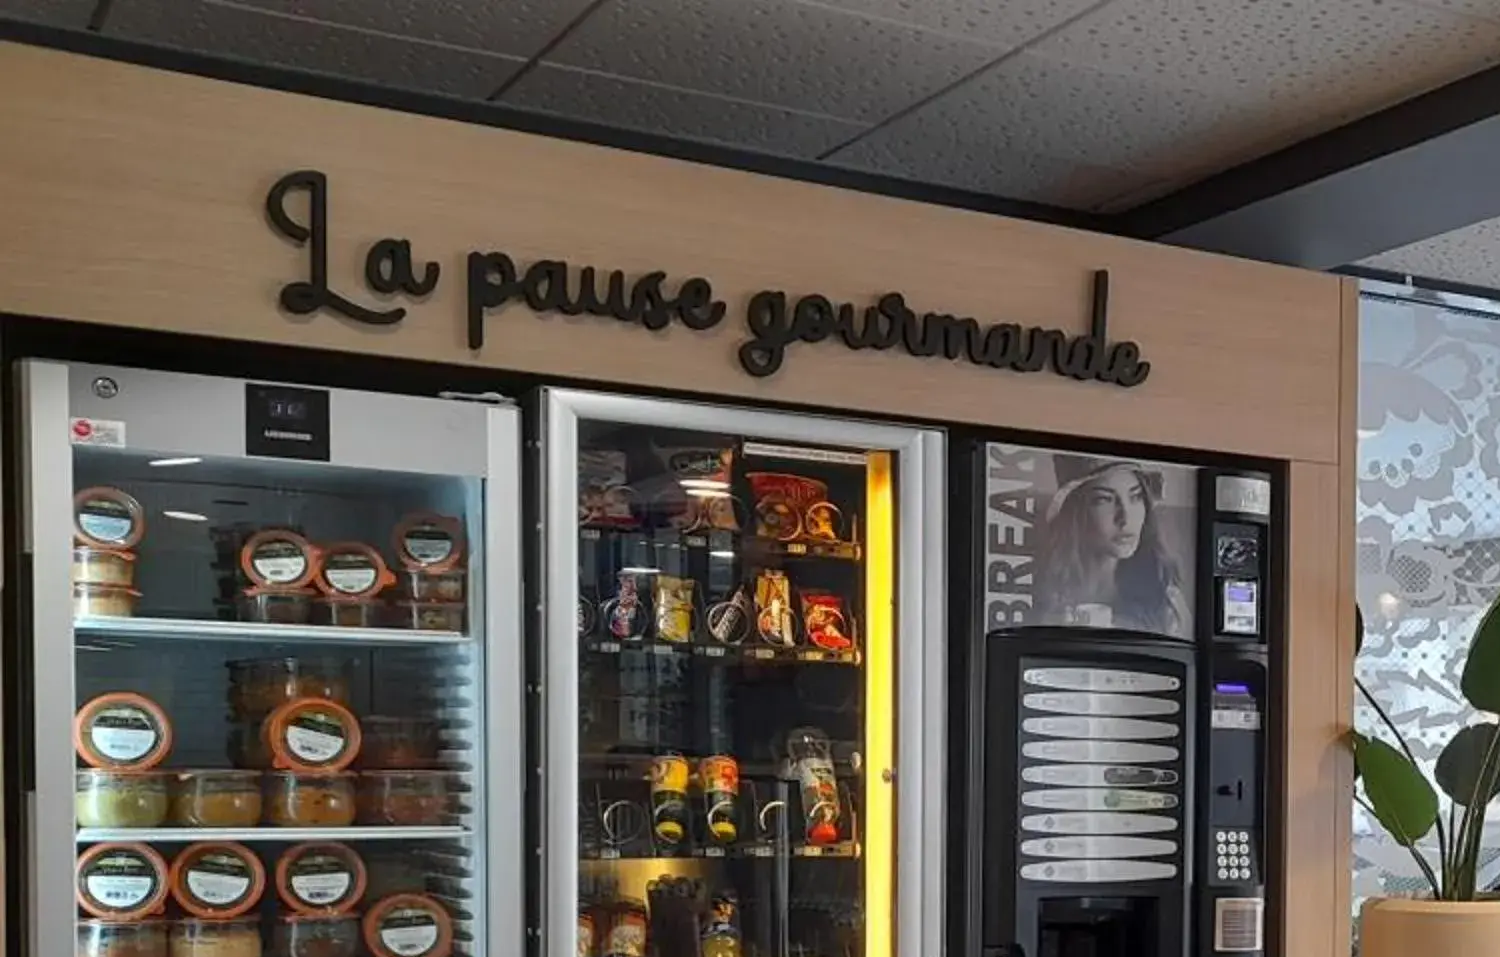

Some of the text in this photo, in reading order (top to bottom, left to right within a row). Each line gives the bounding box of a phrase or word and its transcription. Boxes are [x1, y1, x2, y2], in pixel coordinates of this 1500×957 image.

[265, 169, 1150, 387] La pause gourmande
[988, 444, 1036, 632] BREAK
